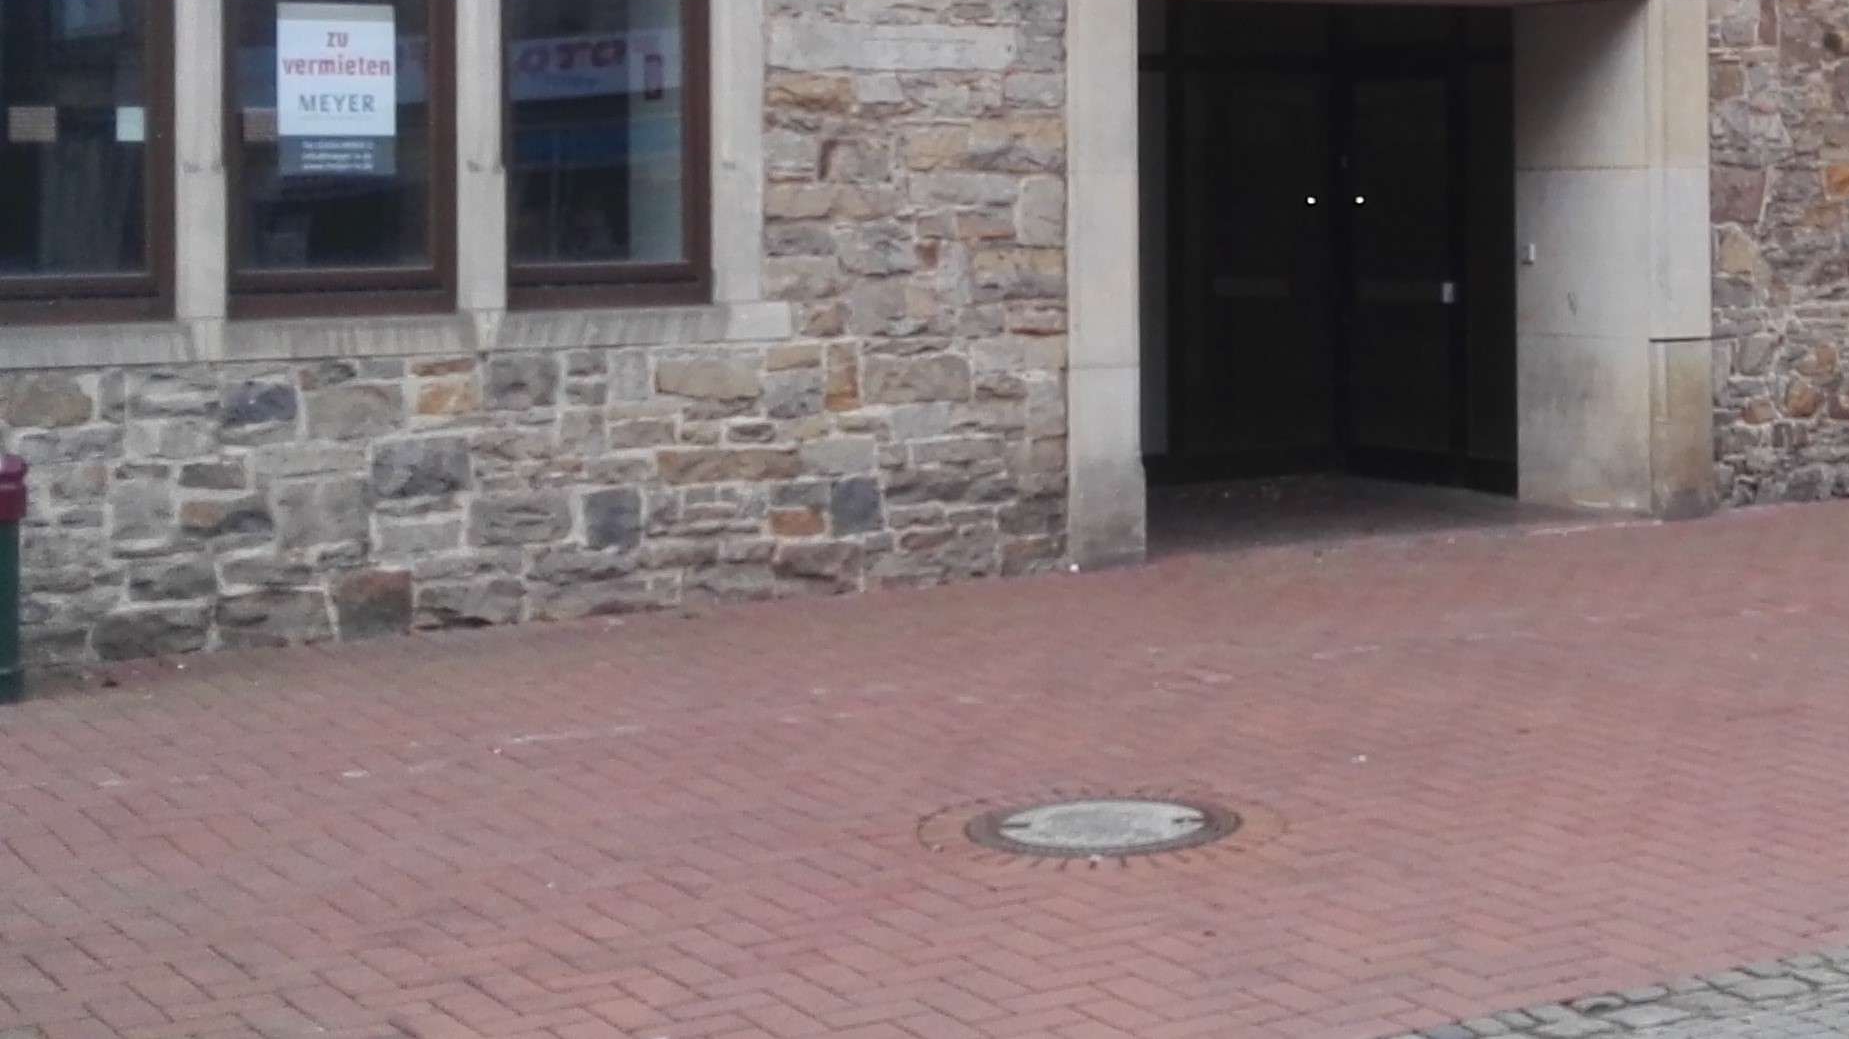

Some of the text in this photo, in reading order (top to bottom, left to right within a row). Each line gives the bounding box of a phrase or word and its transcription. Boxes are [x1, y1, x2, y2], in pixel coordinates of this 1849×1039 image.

[326, 32, 349, 48] zu
[283, 54, 391, 76] vermieten
[299, 94, 376, 112] MEYER
